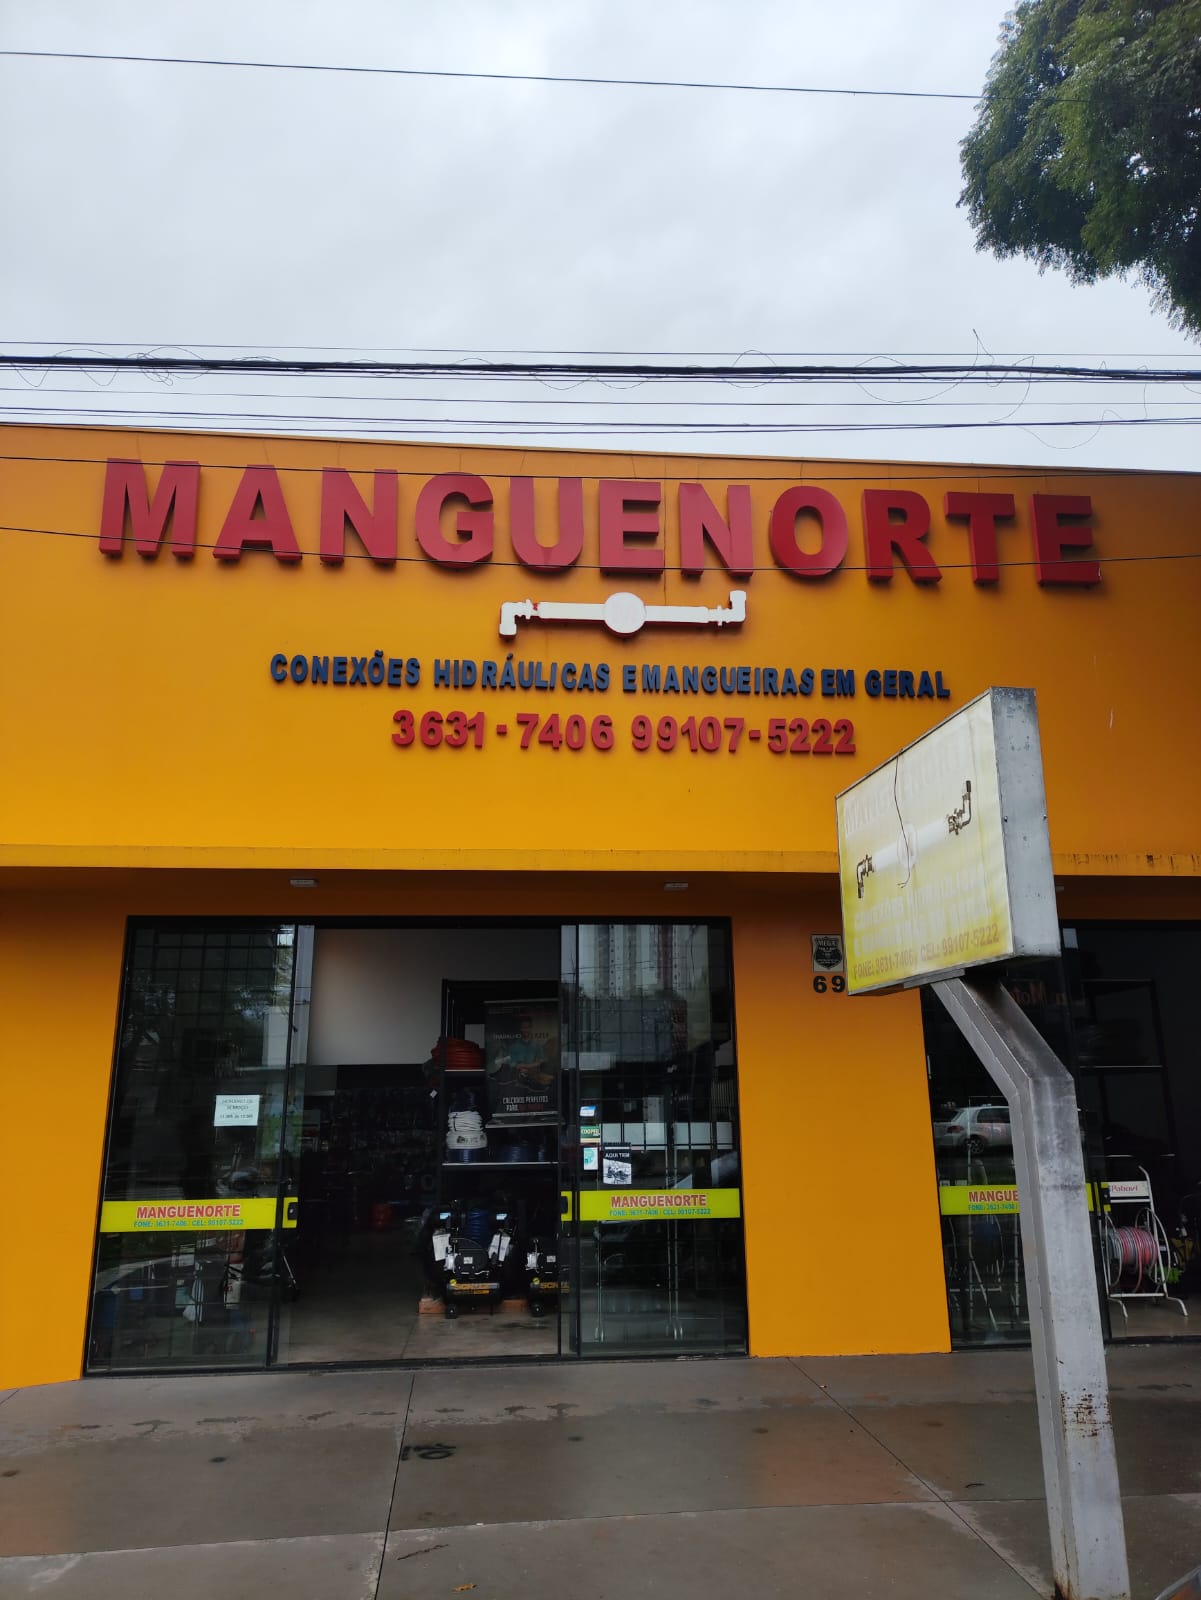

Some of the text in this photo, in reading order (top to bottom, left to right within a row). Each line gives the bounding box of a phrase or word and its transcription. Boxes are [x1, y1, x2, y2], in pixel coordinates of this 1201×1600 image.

[100, 458, 1101, 585] MANGUENORTE
[270, 650, 950, 699] CONEXÕES HIDRÁULICAS E MANGUEIRAS EM GERAL
[631, 716, 856, 754] 99107-5222
[137, 1204, 241, 1219] MANGUENORTE
[611, 1194, 707, 1208] MANGUENORTE
